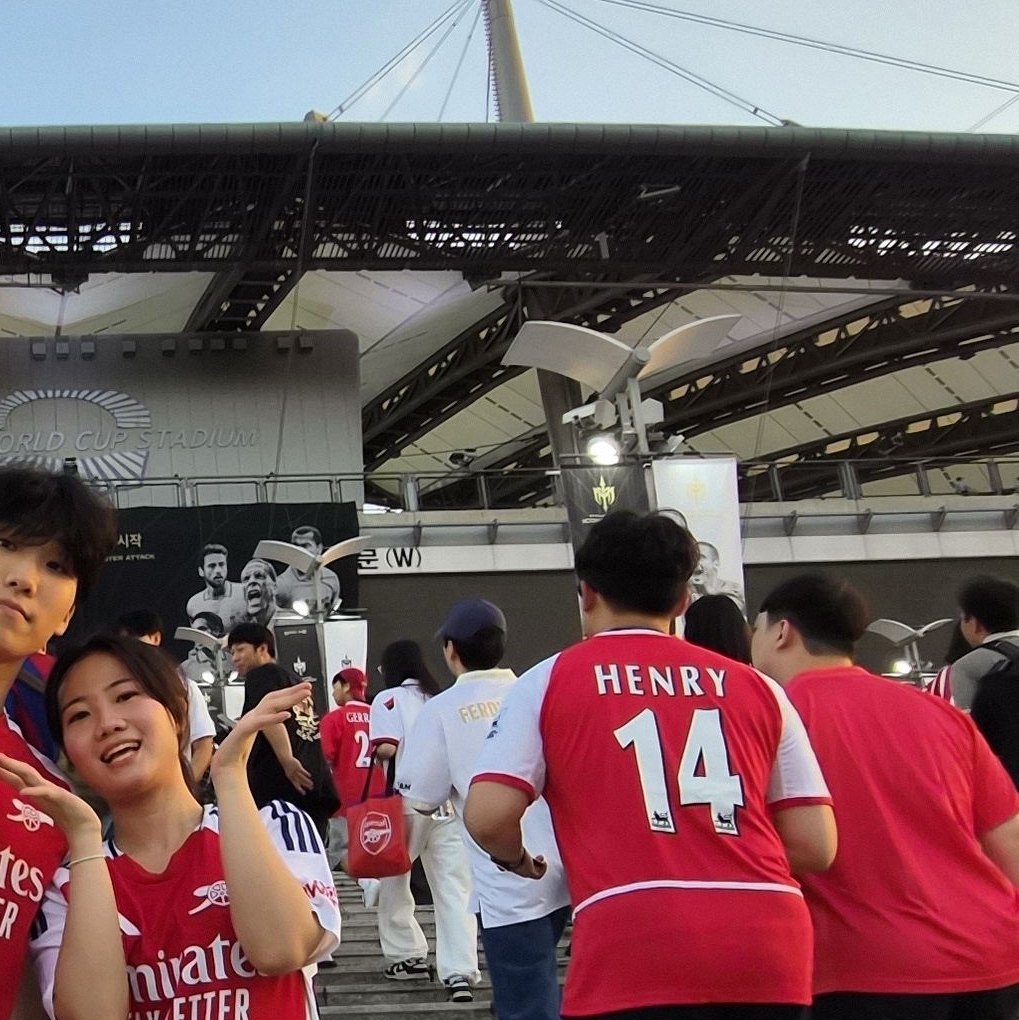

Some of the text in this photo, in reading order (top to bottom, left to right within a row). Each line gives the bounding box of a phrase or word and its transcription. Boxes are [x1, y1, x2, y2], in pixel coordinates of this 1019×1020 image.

[76, 429, 127, 452] CUP
[141, 427, 257, 450] STADIUM
[117, 533, 142, 548] 시작
[593, 664, 726, 697] HENRY
[346, 711, 370, 723] GERR
[613, 707, 745, 836] 14
[126, 933, 270, 1003] mirate
